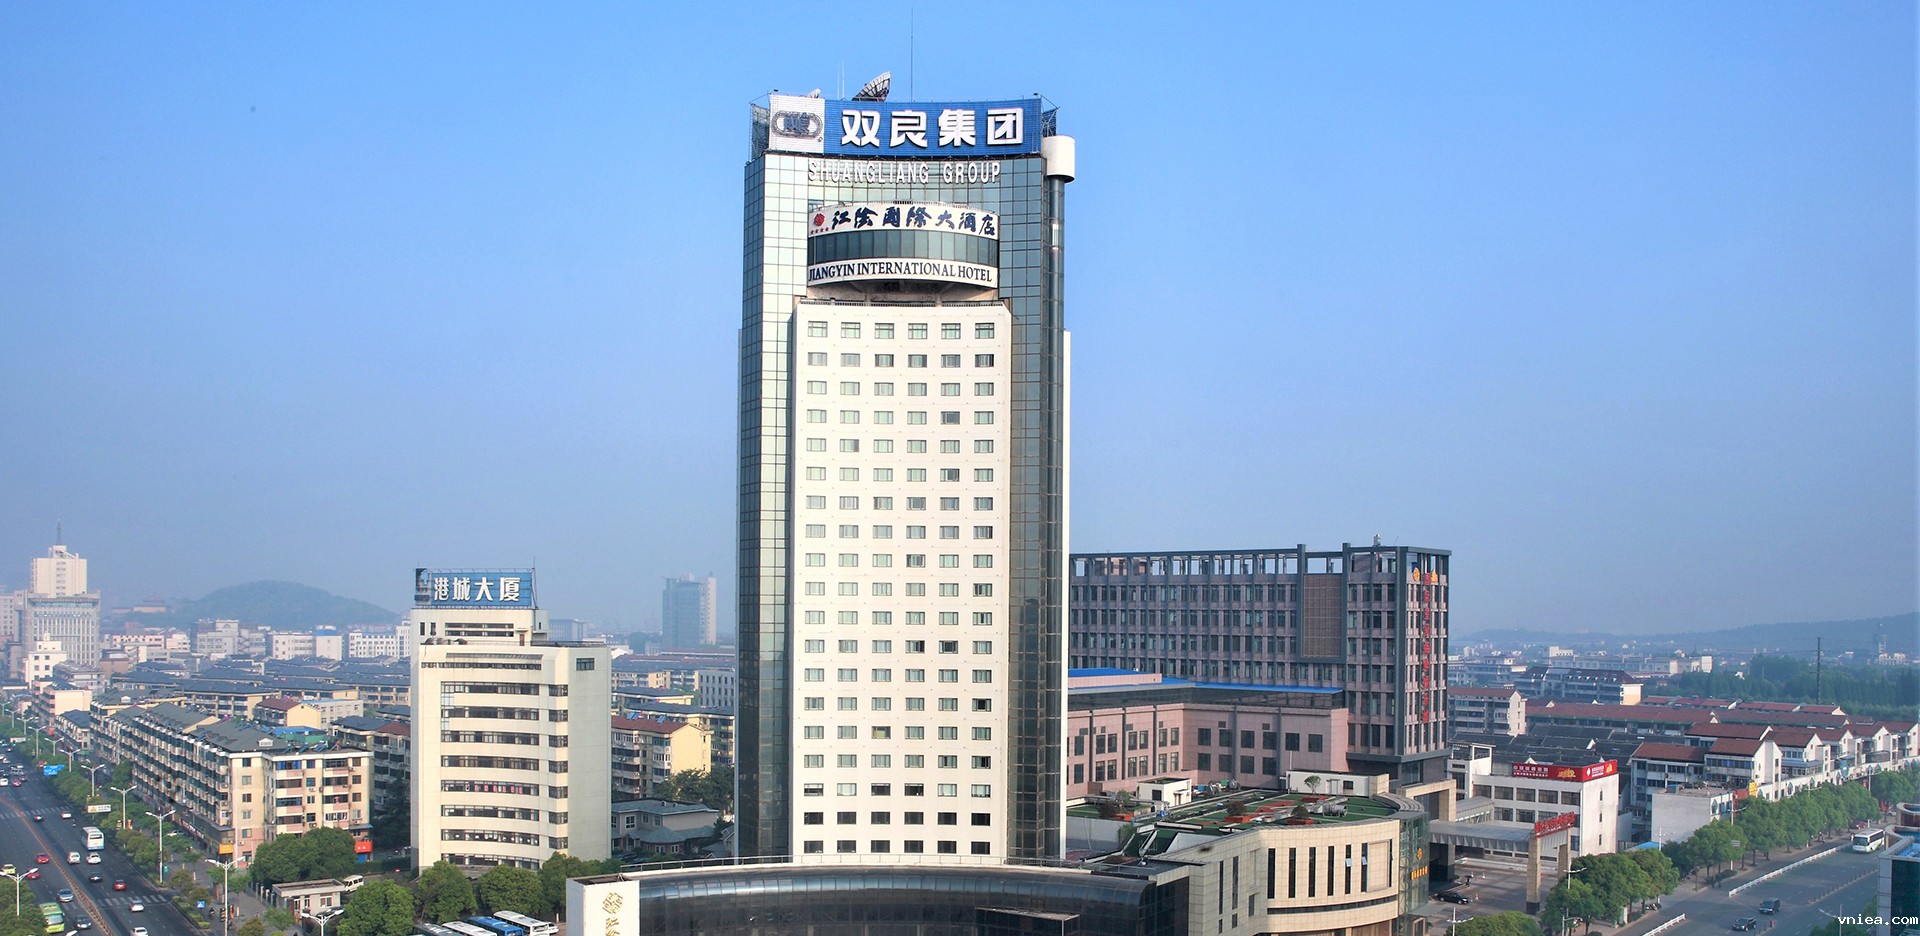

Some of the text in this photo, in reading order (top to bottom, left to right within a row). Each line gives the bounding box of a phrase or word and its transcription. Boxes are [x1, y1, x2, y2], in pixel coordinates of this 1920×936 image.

[841, 108, 1024, 148] 双良集团
[808, 160, 1001, 184] SHUANGLIANG GROUP
[808, 261, 992, 282] JIANGYIN INTERNATIONAL HOTEL
[434, 576, 520, 601] 港城大厦
